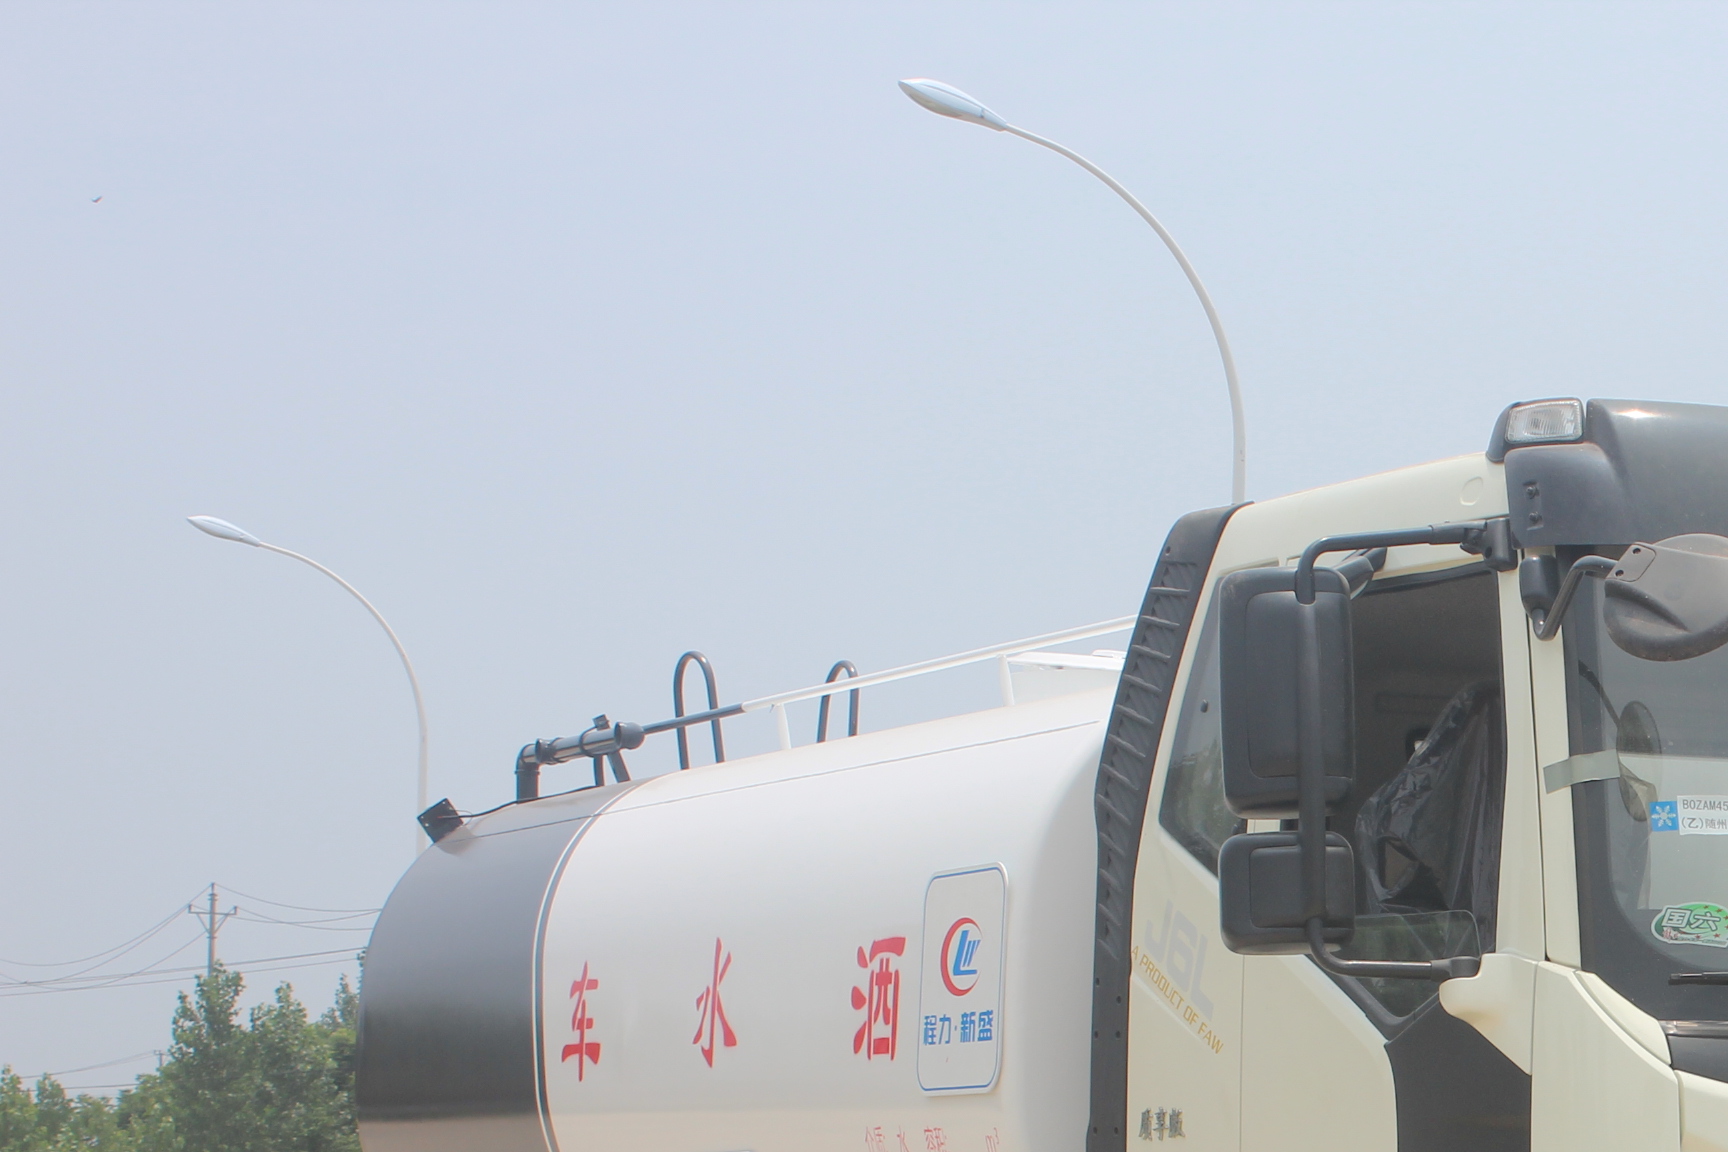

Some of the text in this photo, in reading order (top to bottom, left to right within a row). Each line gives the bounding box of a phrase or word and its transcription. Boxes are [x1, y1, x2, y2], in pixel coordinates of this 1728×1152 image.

[1661, 907, 1721, 931] 国六
[1131, 945, 1224, 1054] A PRODUCT OF FAW
